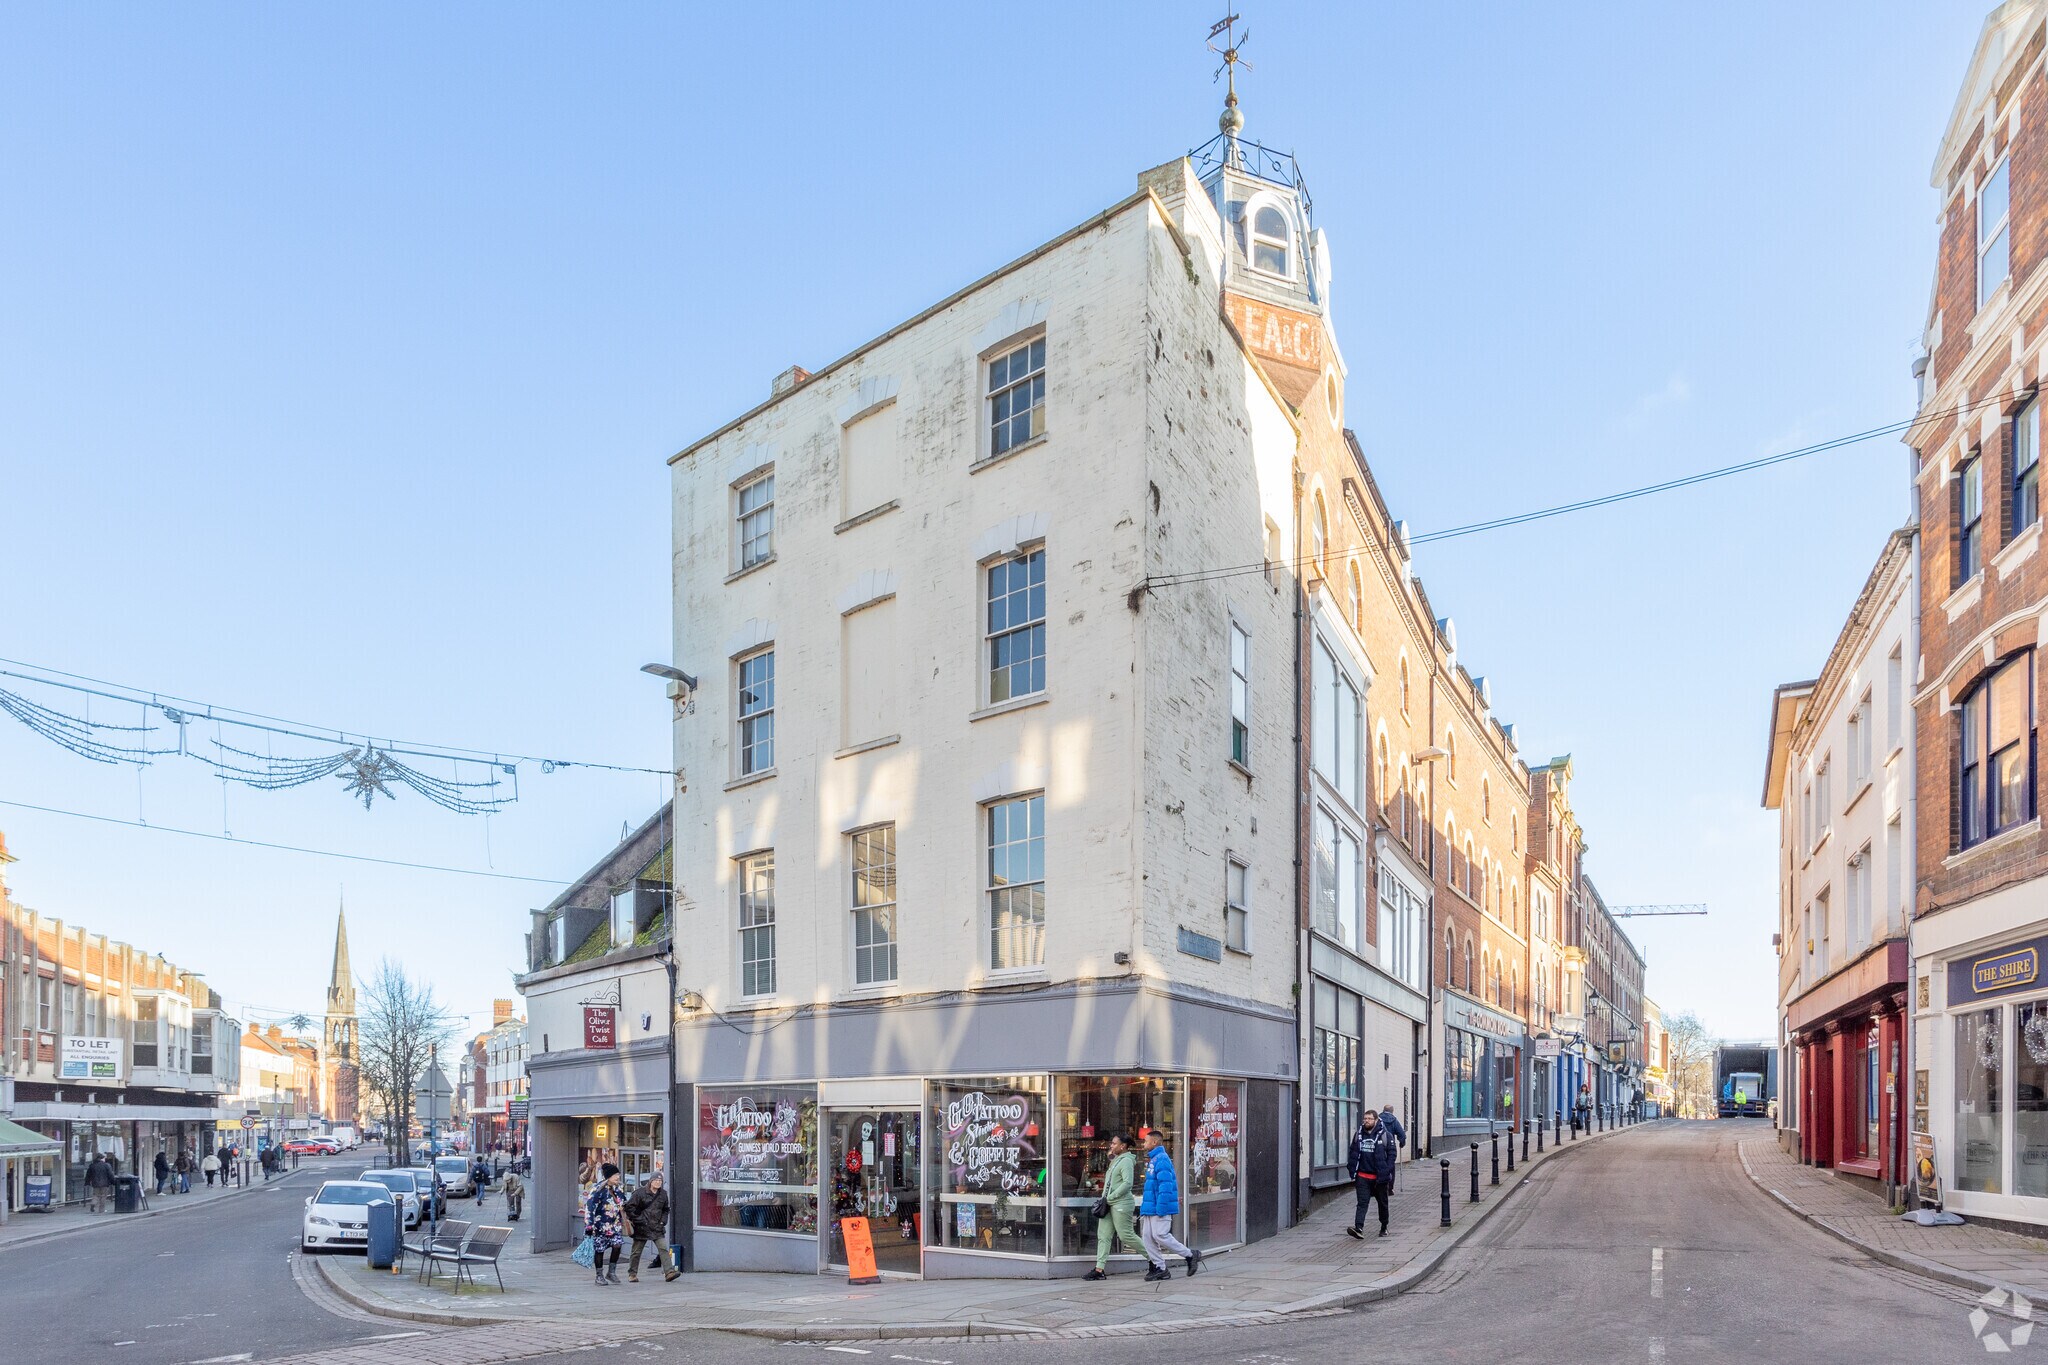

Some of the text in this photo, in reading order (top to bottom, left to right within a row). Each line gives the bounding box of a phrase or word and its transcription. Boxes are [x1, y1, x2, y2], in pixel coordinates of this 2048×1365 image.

[1977, 967, 1998, 983] THE
[1999, 958, 2031, 978] SHIRE
[592, 1009, 607, 1017] The
[588, 1016, 611, 1025] Oliver
[589, 1025, 611, 1034] Twist
[70, 1039, 110, 1049] TO LET
[738, 1142, 803, 1154] GUINNESS WORLD RECORD
